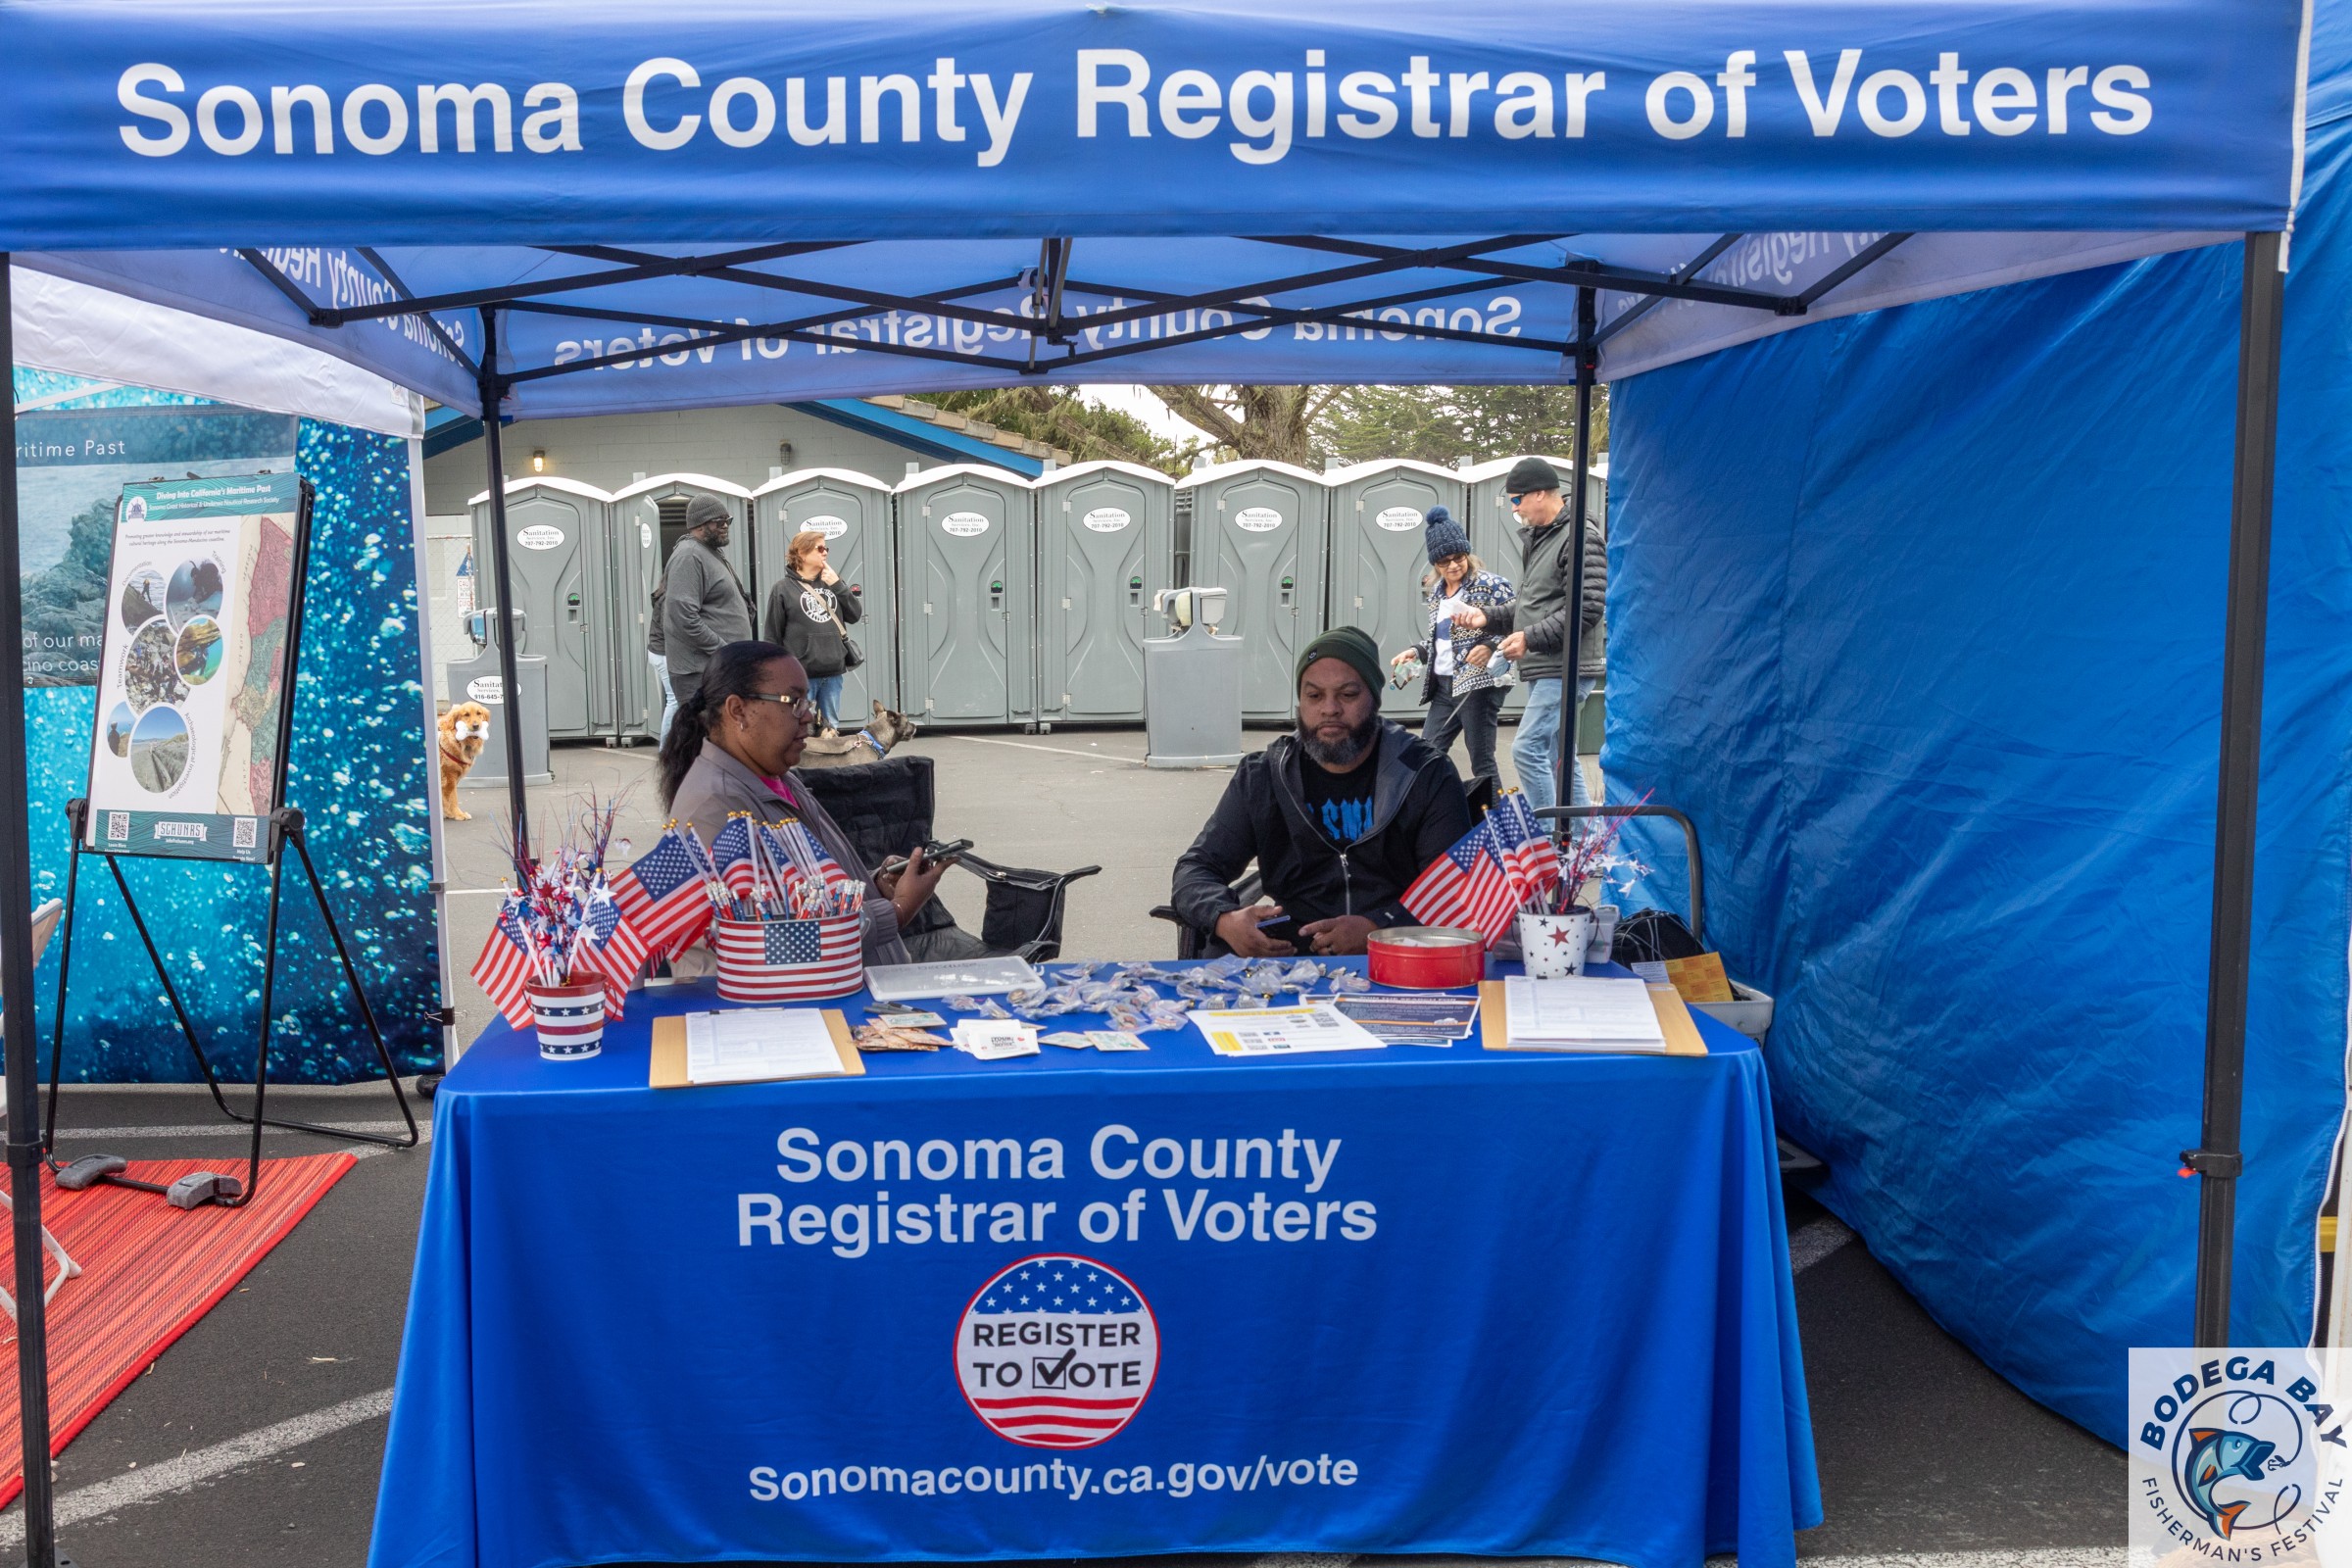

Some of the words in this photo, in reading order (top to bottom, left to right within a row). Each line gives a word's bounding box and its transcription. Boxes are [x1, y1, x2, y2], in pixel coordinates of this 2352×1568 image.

[117, 63, 582, 157] Sonoma
[623, 57, 1033, 167] County
[1077, 49, 1605, 165] Registrar
[1645, 50, 1756, 137] of
[1783, 49, 2152, 137] Voters
[17, 442, 75, 458] ritime
[85, 439, 125, 456] Past
[157, 491, 176, 500] Diving
[190, 487, 225, 498] California's
[226, 486, 255, 495] Maritime
[257, 484, 271, 493] Past
[122, 560, 153, 587] Documentation
[212, 551, 226, 574] Training
[23, 632, 38, 649] of
[43, 636, 74, 649] our
[79, 633, 103, 647] ma
[22, 659, 53, 672] cino
[58, 659, 100, 672] coas
[117, 644, 129, 690] Teamwork
[473, 679, 503, 688] Sanitat
[168, 763, 195, 800] Investigation
[160, 822, 201, 837] SCHUNRS
[777, 1127, 1064, 1183] Sonoma
[1090, 1124, 1342, 1193] County
[738, 1191, 1055, 1258] Registrar
[1079, 1189, 1146, 1243] of
[1162, 1189, 1377, 1242] Voters
[972, 1320, 1141, 1348] REGISTER
[972, 1361, 1023, 1388] TO
[749, 1452, 1358, 1502] Sonomacounty.ca.gov/vote
